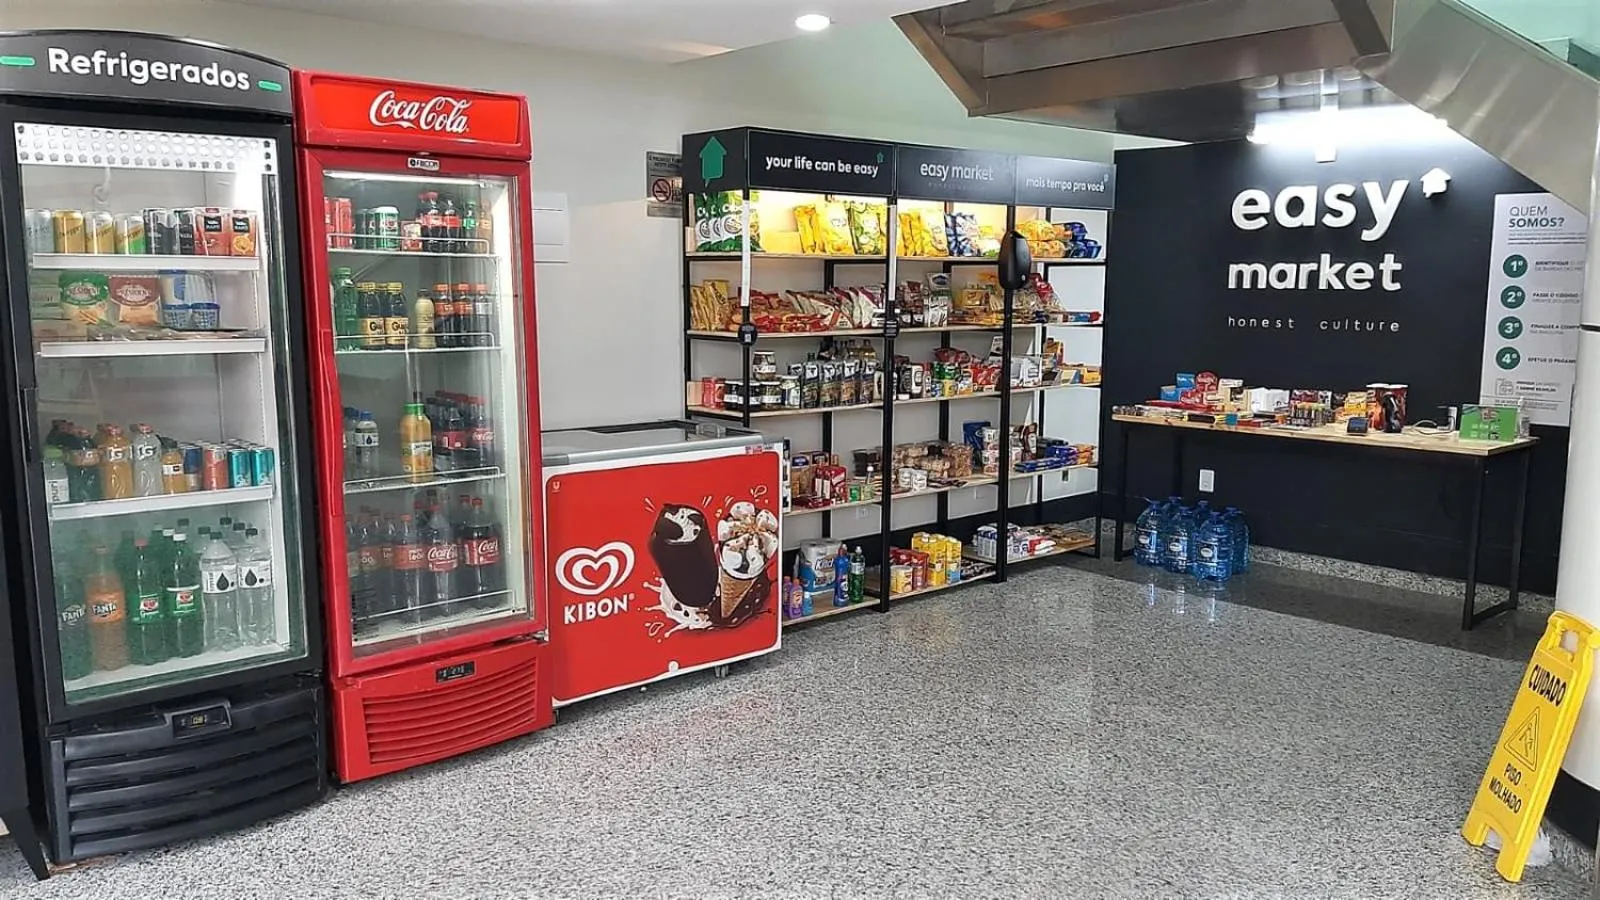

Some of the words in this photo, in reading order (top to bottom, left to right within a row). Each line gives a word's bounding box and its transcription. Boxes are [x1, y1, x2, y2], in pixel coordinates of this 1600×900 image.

[48, 48, 250, 91] Refrigerados
[369, 90, 472, 133] Coca-Cola
[765, 156, 793, 170] your
[794, 156, 813, 170] life
[815, 160, 836, 171] can
[837, 160, 852, 173] be
[853, 164, 879, 178] easy
[920, 163, 949, 181] easy
[951, 166, 994, 181] market
[1026, 177, 1046, 188] mais
[1046, 178, 1072, 191] tempo
[1073, 181, 1086, 192] pra
[1087, 180, 1105, 192] você
[1231, 179, 1410, 241] easy
[1509, 218, 1565, 228] SOMOS?
[1510, 206, 1548, 217] QUEM
[1228, 253, 1402, 291] market
[1228, 316, 1296, 328] honest
[1319, 318, 1401, 332] culture
[564, 594, 628, 624] KIBON
[1528, 664, 1567, 707] CUIDADO
[1503, 762, 1522, 786] PISO
[1489, 776, 1522, 814] MOLHADO
